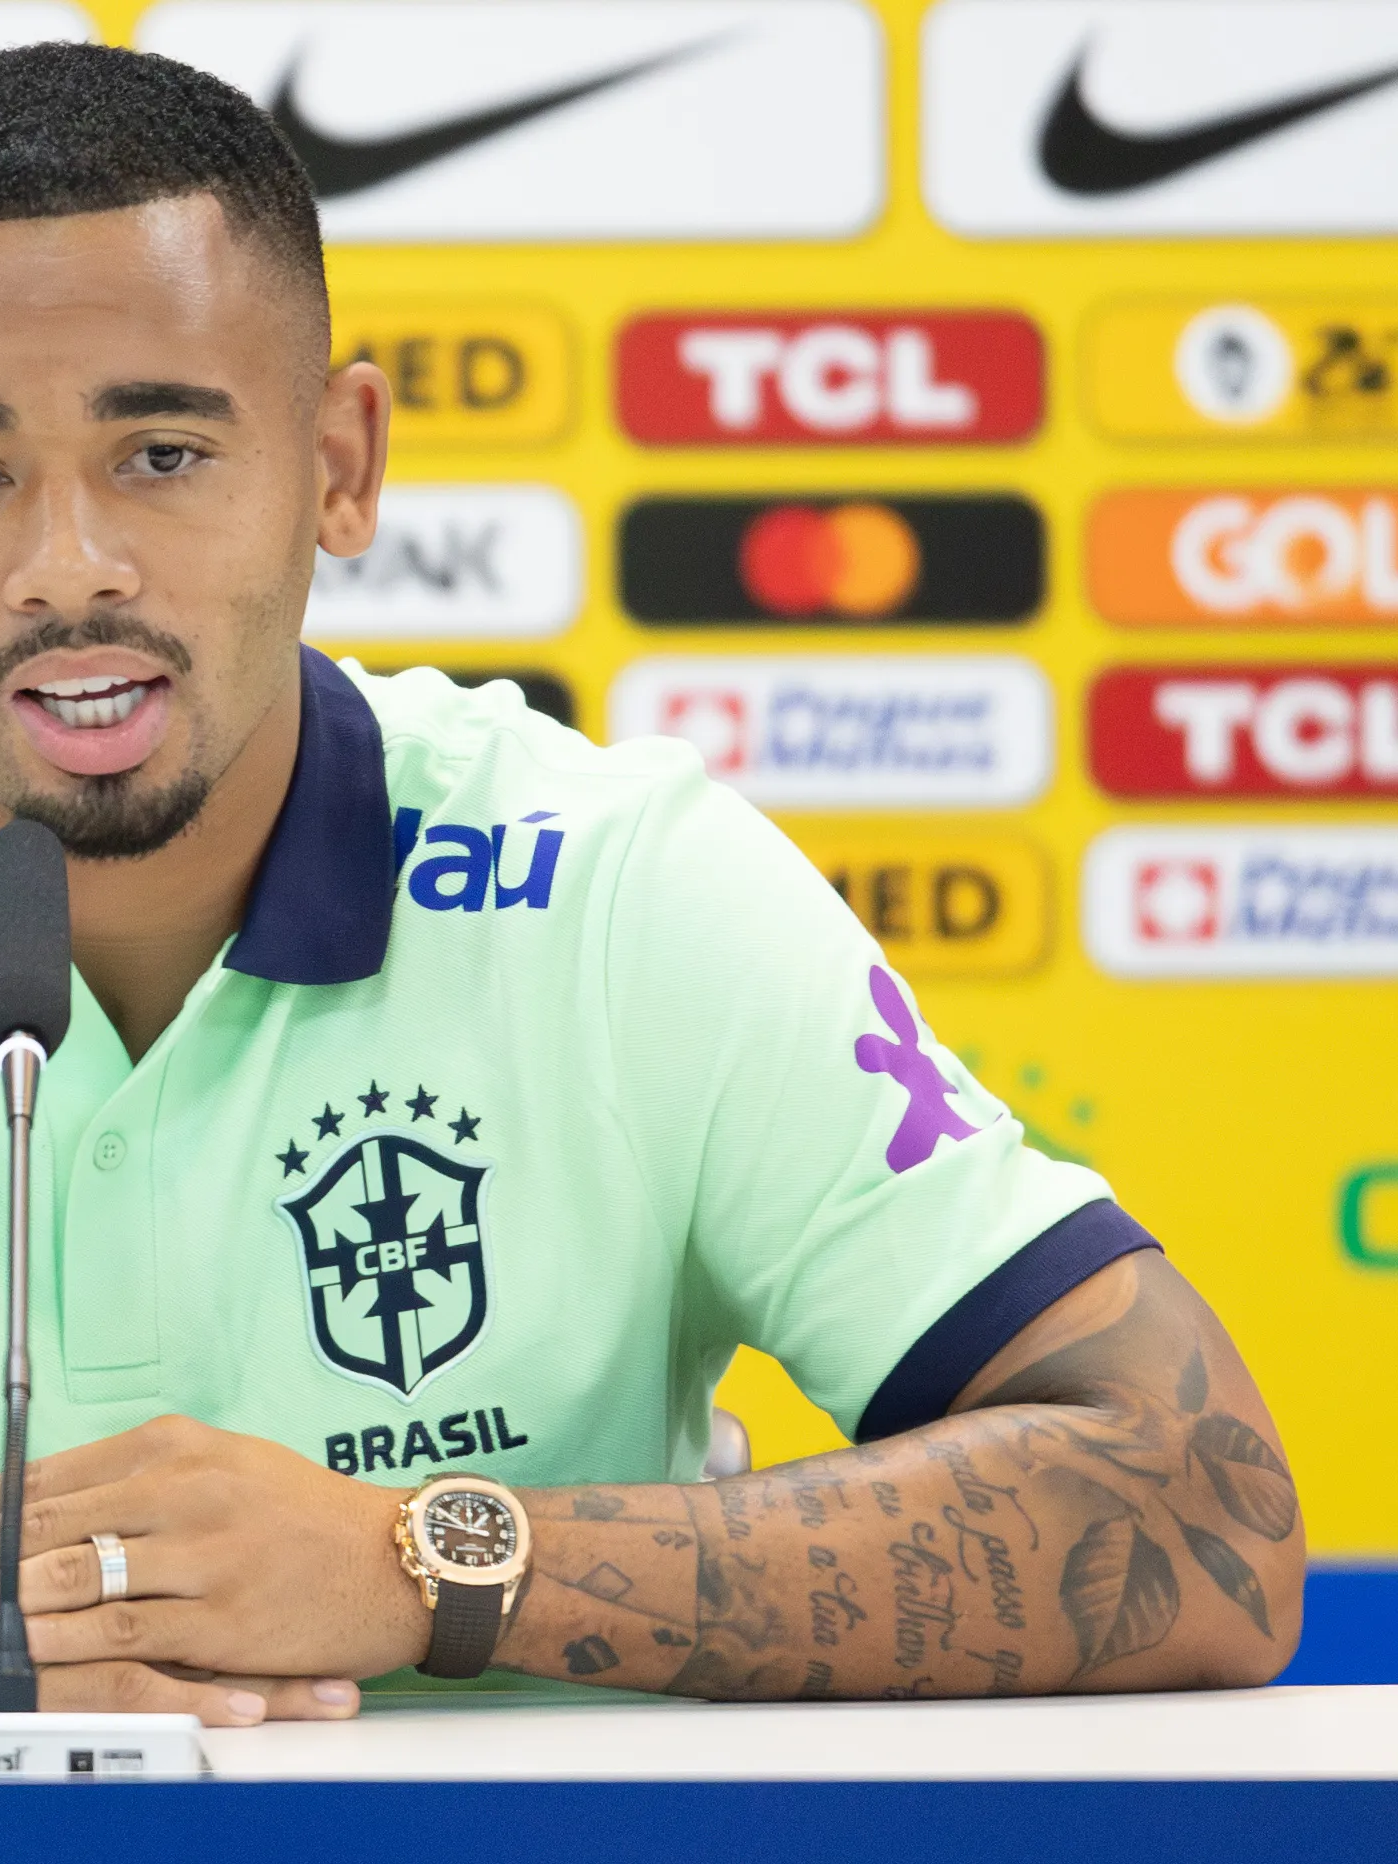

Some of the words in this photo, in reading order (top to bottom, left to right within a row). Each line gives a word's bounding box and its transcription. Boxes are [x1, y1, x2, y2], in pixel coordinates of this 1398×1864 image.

[347, 334, 528, 412] ED
[678, 327, 978, 432] TCL
[354, 1235, 428, 1277] CBF
[324, 1406, 529, 1477] BRASIL
